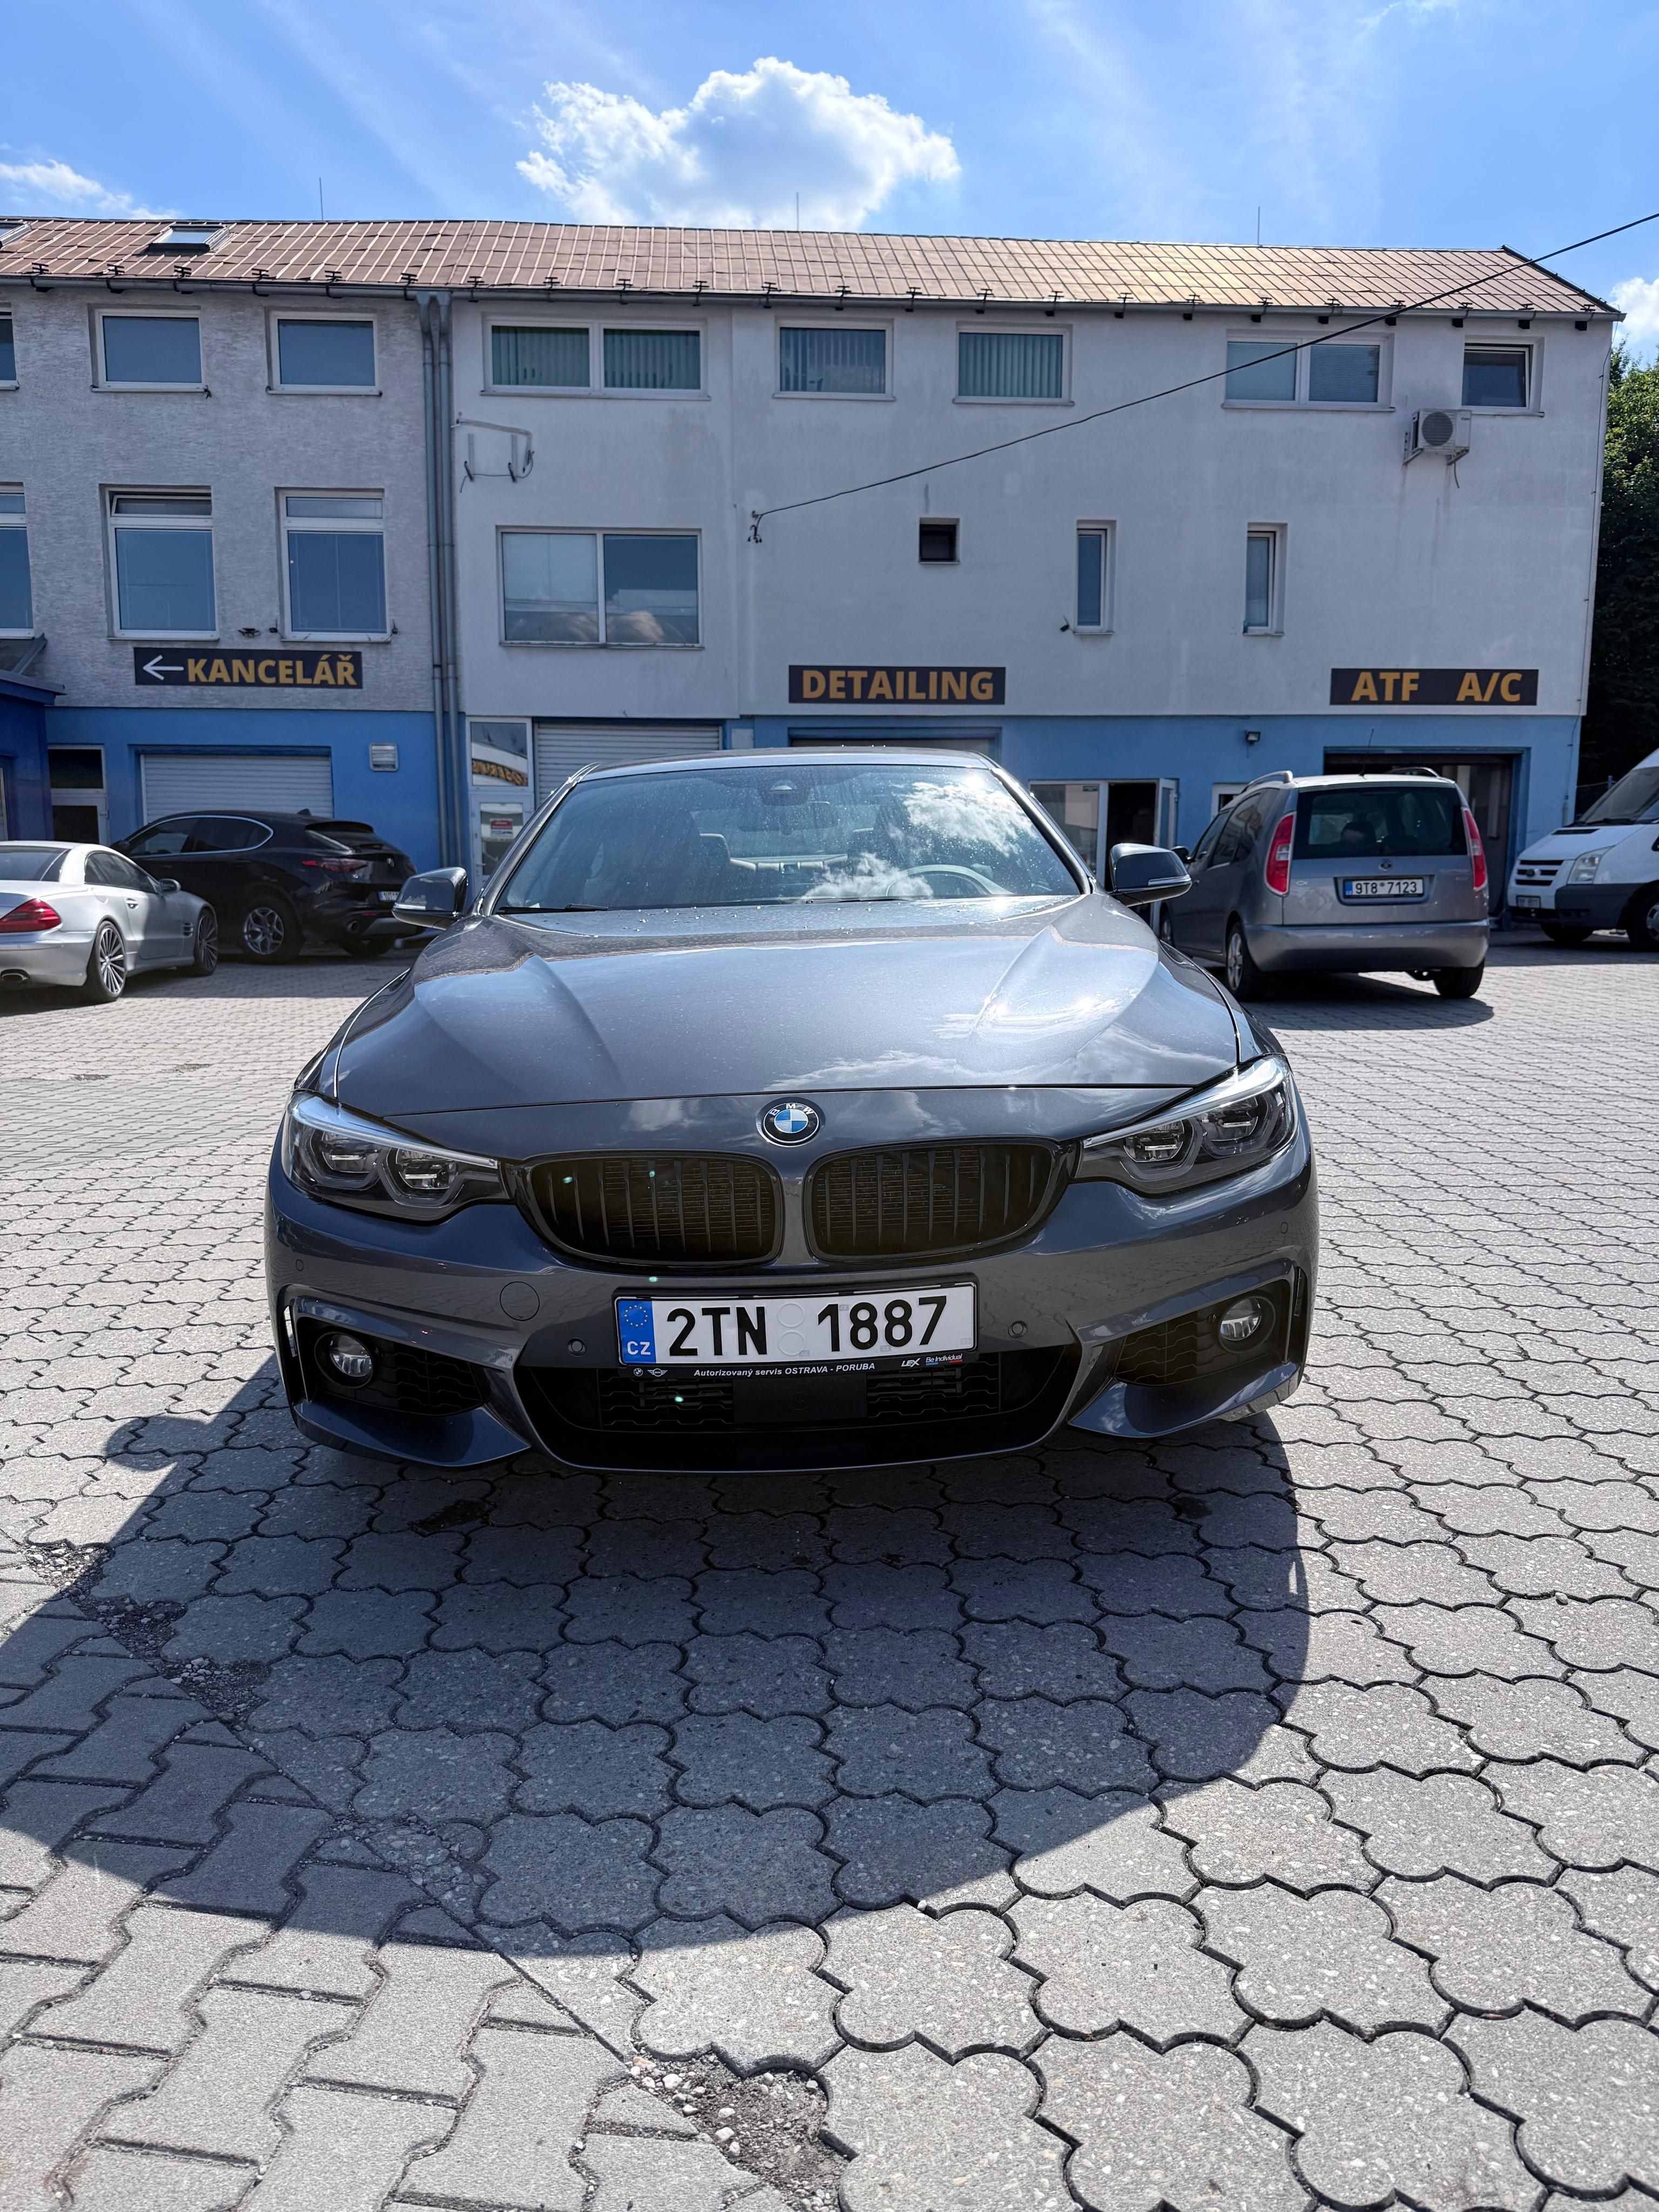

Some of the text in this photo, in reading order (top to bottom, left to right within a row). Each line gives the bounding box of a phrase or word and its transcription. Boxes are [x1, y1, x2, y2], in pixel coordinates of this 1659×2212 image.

[187, 654, 358, 686] KANCELÁŘ
[802, 670, 994, 700] DETAILING
[1351, 671, 1522, 702] ATF A/C
[1355, 881, 1417, 894] 9T8 7123
[769, 1103, 814, 1116] BMW
[666, 1295, 947, 1357] 2TN 1887
[626, 1341, 651, 1355] CZ
[901, 1358, 921, 1367] LEX
[935, 1353, 963, 1362] Individual
[693, 1368, 753, 1377] Autorizovaný
[785, 1366, 828, 1374] OSTRAVA
[836, 1363, 875, 1372] PORUBA
